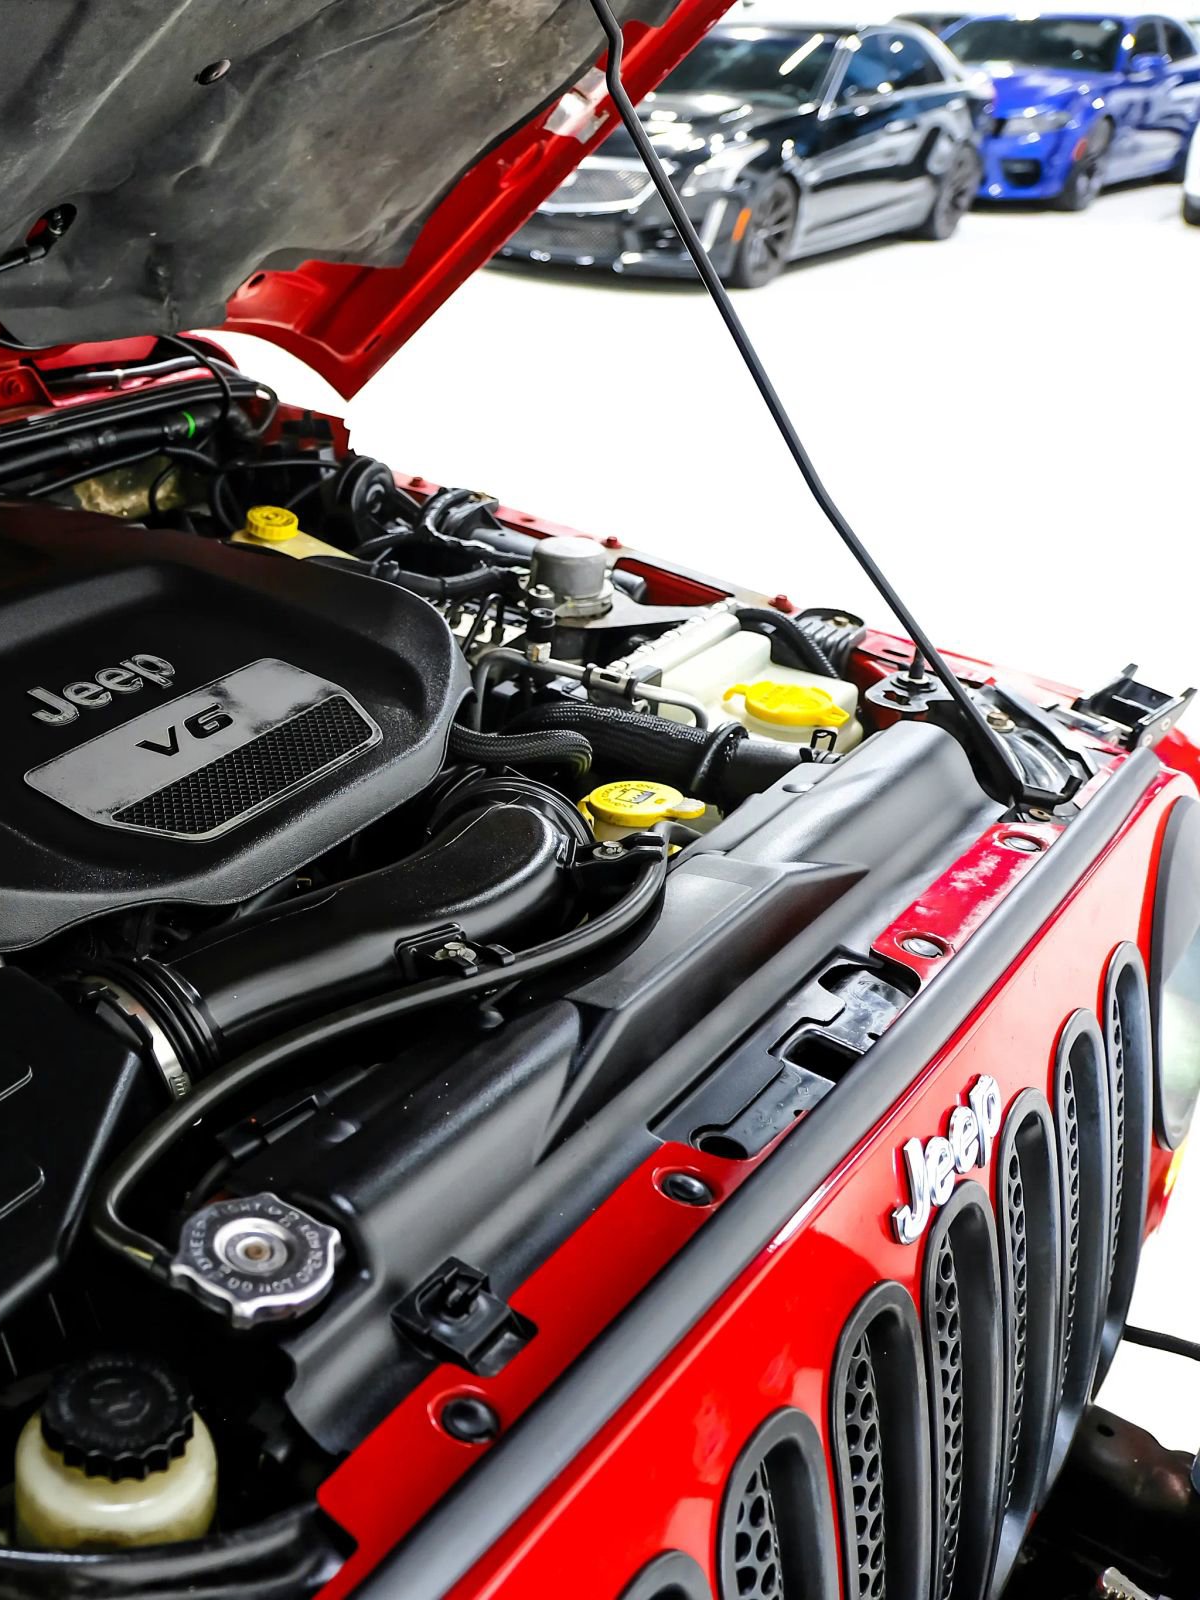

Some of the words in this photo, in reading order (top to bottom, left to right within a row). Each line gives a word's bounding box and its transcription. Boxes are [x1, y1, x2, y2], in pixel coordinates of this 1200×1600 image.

[27, 654, 176, 726] Jeep
[135, 703, 234, 757] V6
[892, 1074, 1001, 1245] Jeep
